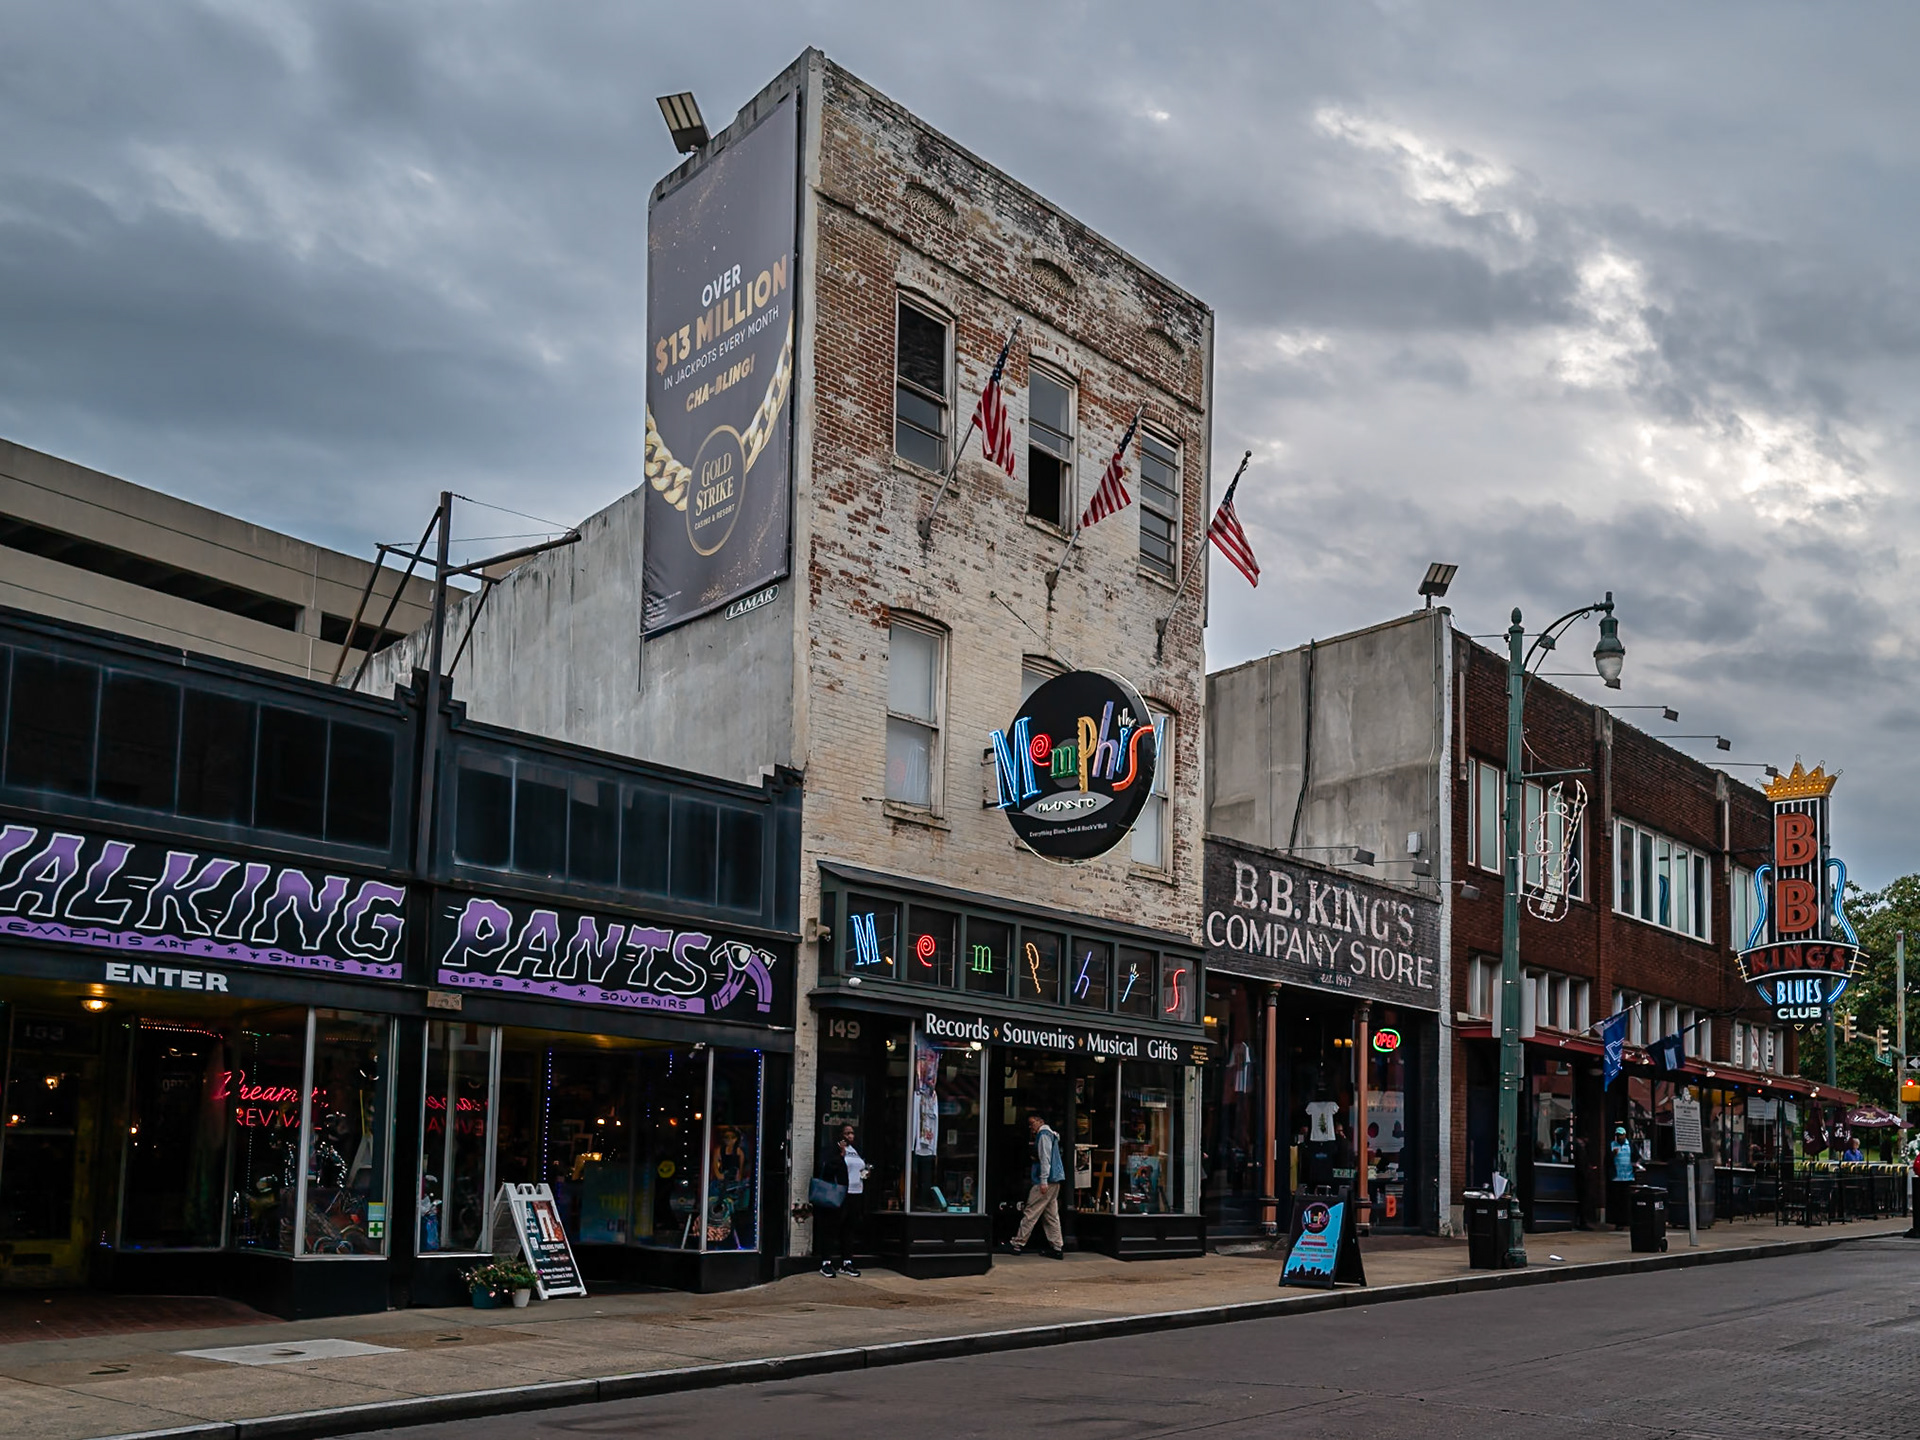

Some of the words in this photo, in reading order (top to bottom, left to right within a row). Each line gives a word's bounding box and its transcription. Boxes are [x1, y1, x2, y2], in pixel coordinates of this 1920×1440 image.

[702, 264, 741, 307] OVER
[656, 336, 691, 376] $13
[696, 254, 787, 350] MILLION
[664, 375, 673, 391] IN
[675, 348, 717, 384] JACKPOTS
[719, 328, 746, 357] EVERY
[748, 305, 779, 338] MONTH
[701, 452, 732, 488] GOLD
[695, 475, 735, 516] STRIKE
[694, 516, 711, 531] CASINO
[712, 514, 716, 522] &
[716, 503, 735, 519] RESORT
[728, 591, 774, 617] LAMAR
[988, 701, 1154, 809] Memphis
[1029, 829, 1053, 838] Everything
[1307, 879, 1414, 947] KING'S
[154, 938, 193, 951] ART
[268, 951, 345, 971] SHIRTS
[442, 897, 712, 995] PANTS
[1206, 911, 1343, 970] COMPANY
[105, 962, 229, 992] ENTER
[1350, 940, 1433, 990] STORE
[1751, 945, 1847, 973] KING'S
[449, 974, 504, 988] GIFTS
[599, 990, 688, 1010] SOUVENIRS
[1776, 978, 1822, 1004] BLUES
[829, 1019, 860, 1039] 149
[1777, 1006, 1822, 1020] CLUB
[926, 1013, 990, 1040] Records
[1003, 1023, 1075, 1050] Souvenirs
[1087, 1033, 1138, 1057] Musical
[1148, 1039, 1178, 1061] Gifts
[1376, 1032, 1397, 1049] OPEN
